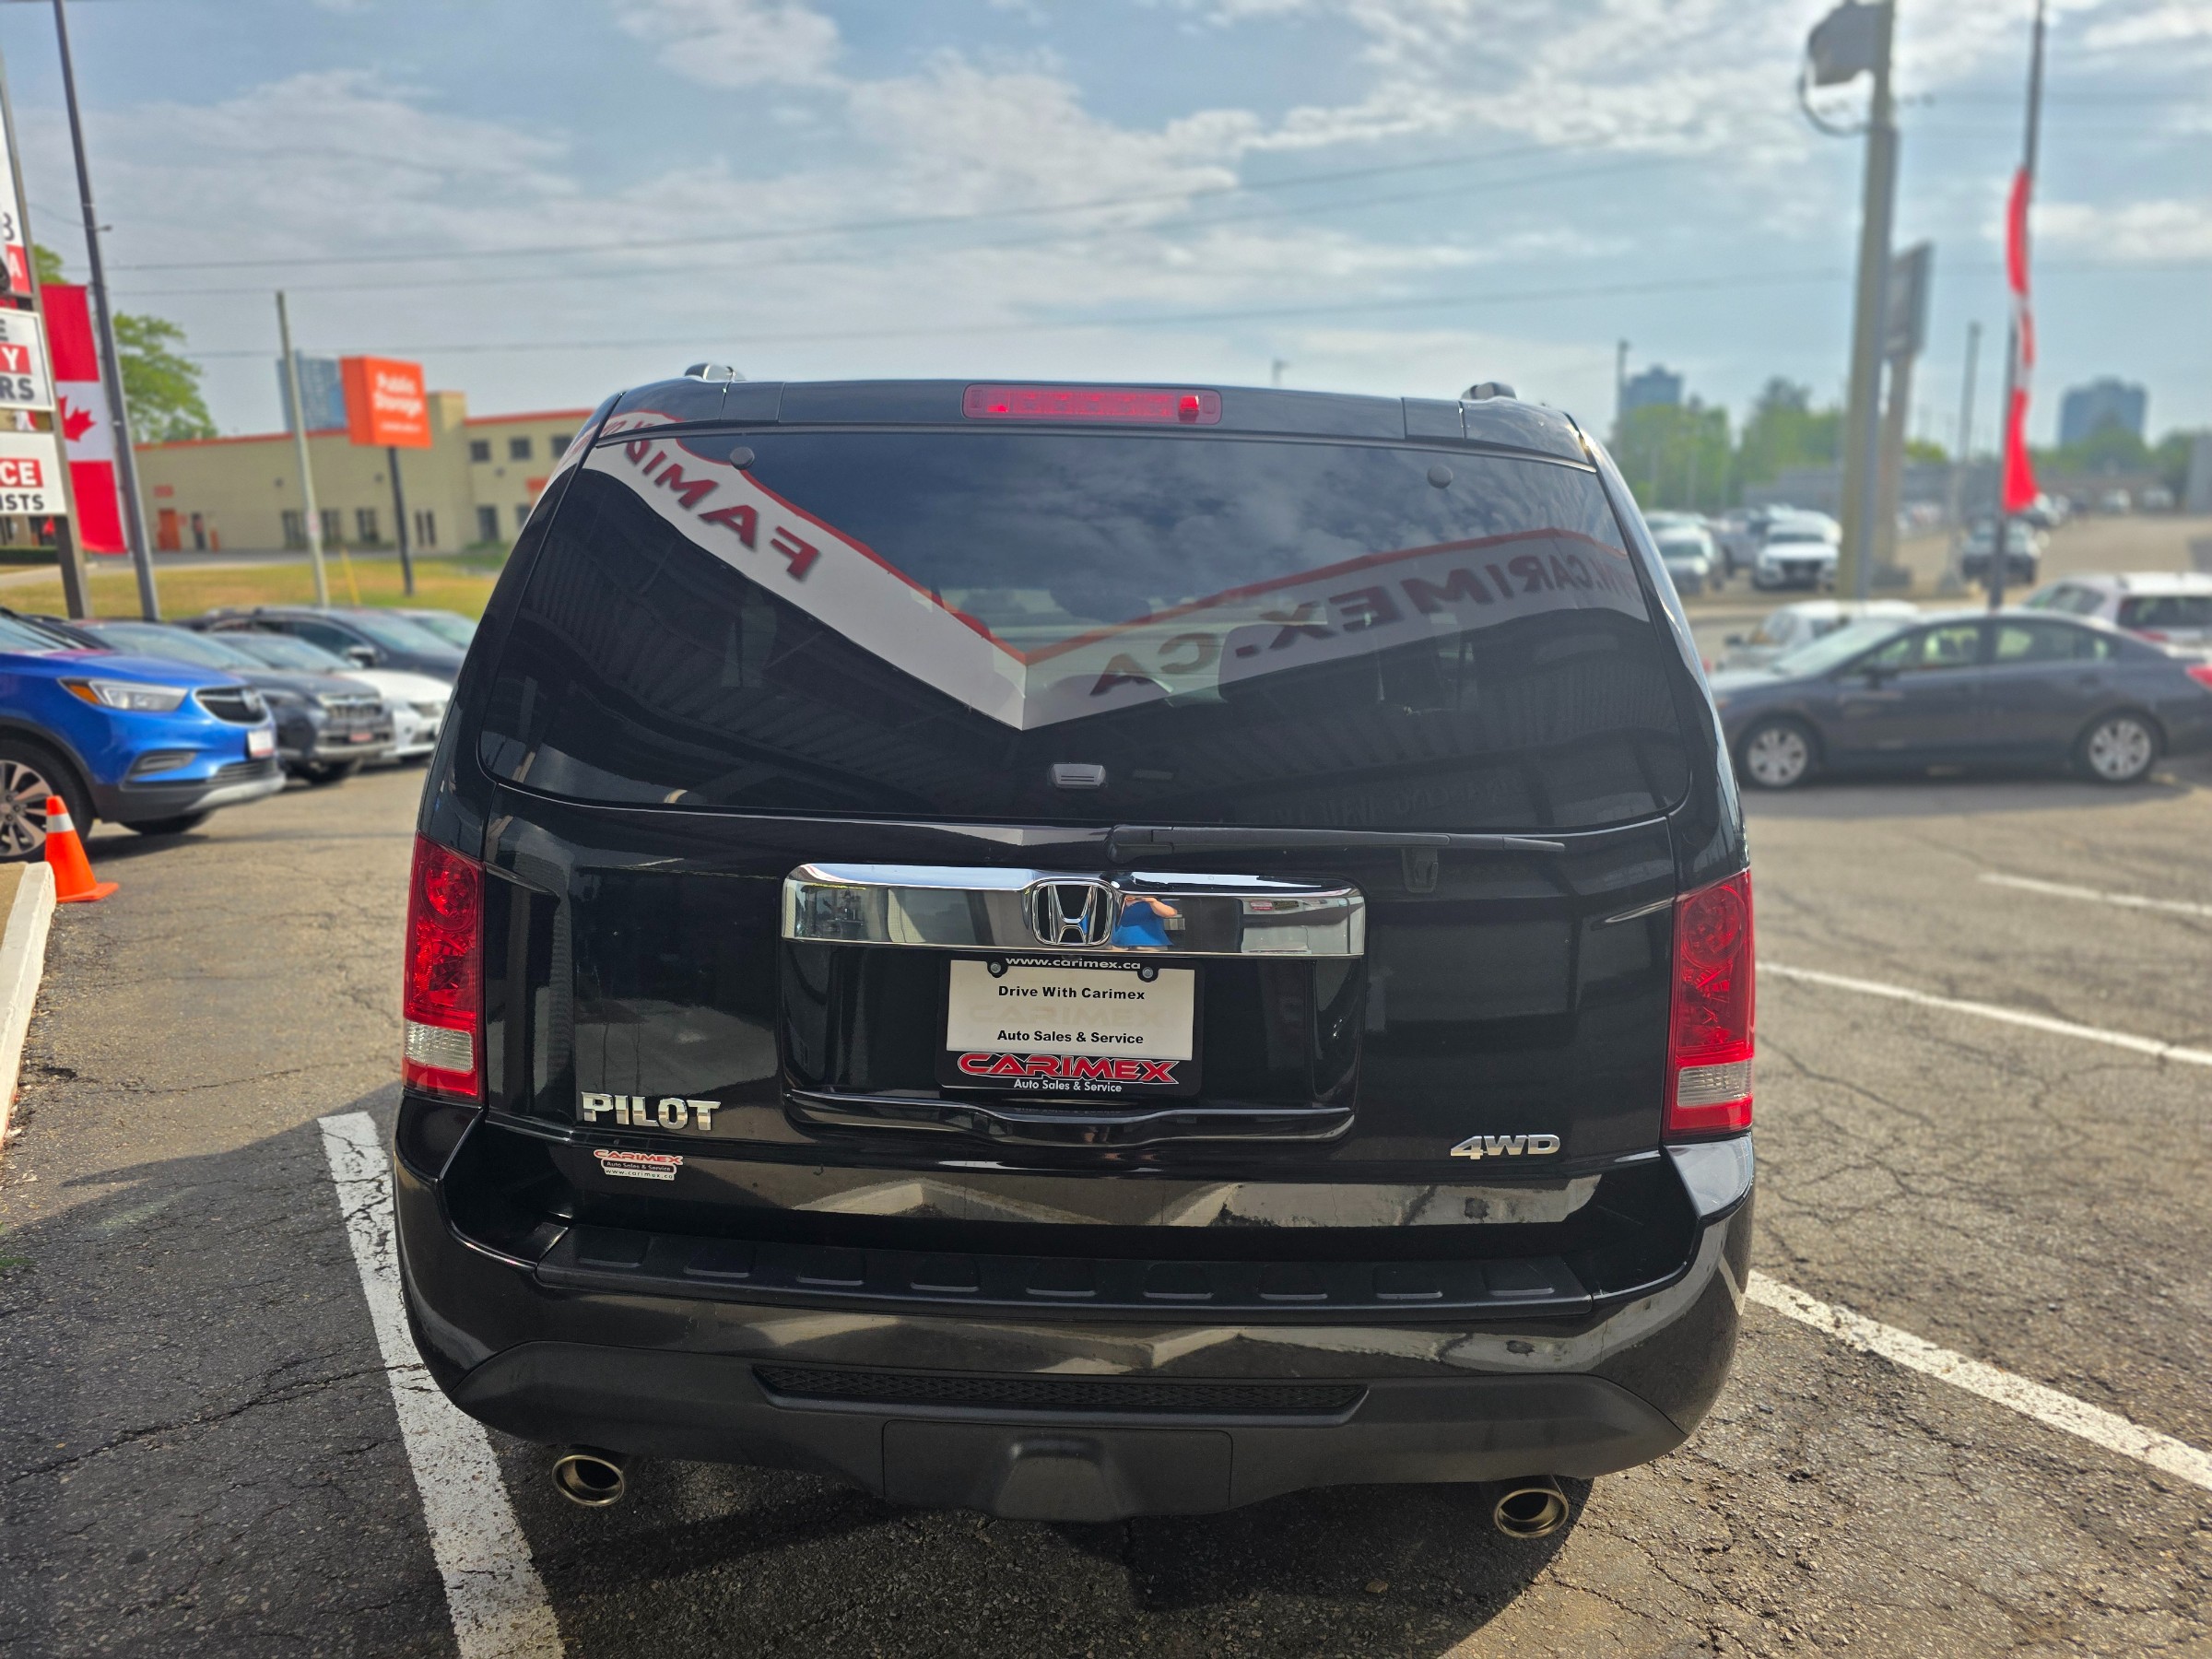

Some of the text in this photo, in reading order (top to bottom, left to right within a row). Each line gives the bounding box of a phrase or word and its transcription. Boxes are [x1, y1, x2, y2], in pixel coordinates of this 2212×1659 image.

[0, 460, 38, 487] CE
[1006, 958, 1141, 970] www.carimex.ca
[998, 985, 1146, 1000] Drive With Carimex
[997, 1030, 1144, 1044] Auto Sales & Service
[958, 1053, 1180, 1084] CARIMEX
[1014, 1078, 1123, 1093] Auto Sales & Service
[581, 1091, 722, 1131] PILOT
[1450, 1134, 1561, 1160] 4WD
[594, 1150, 682, 1164] CARIMEX
